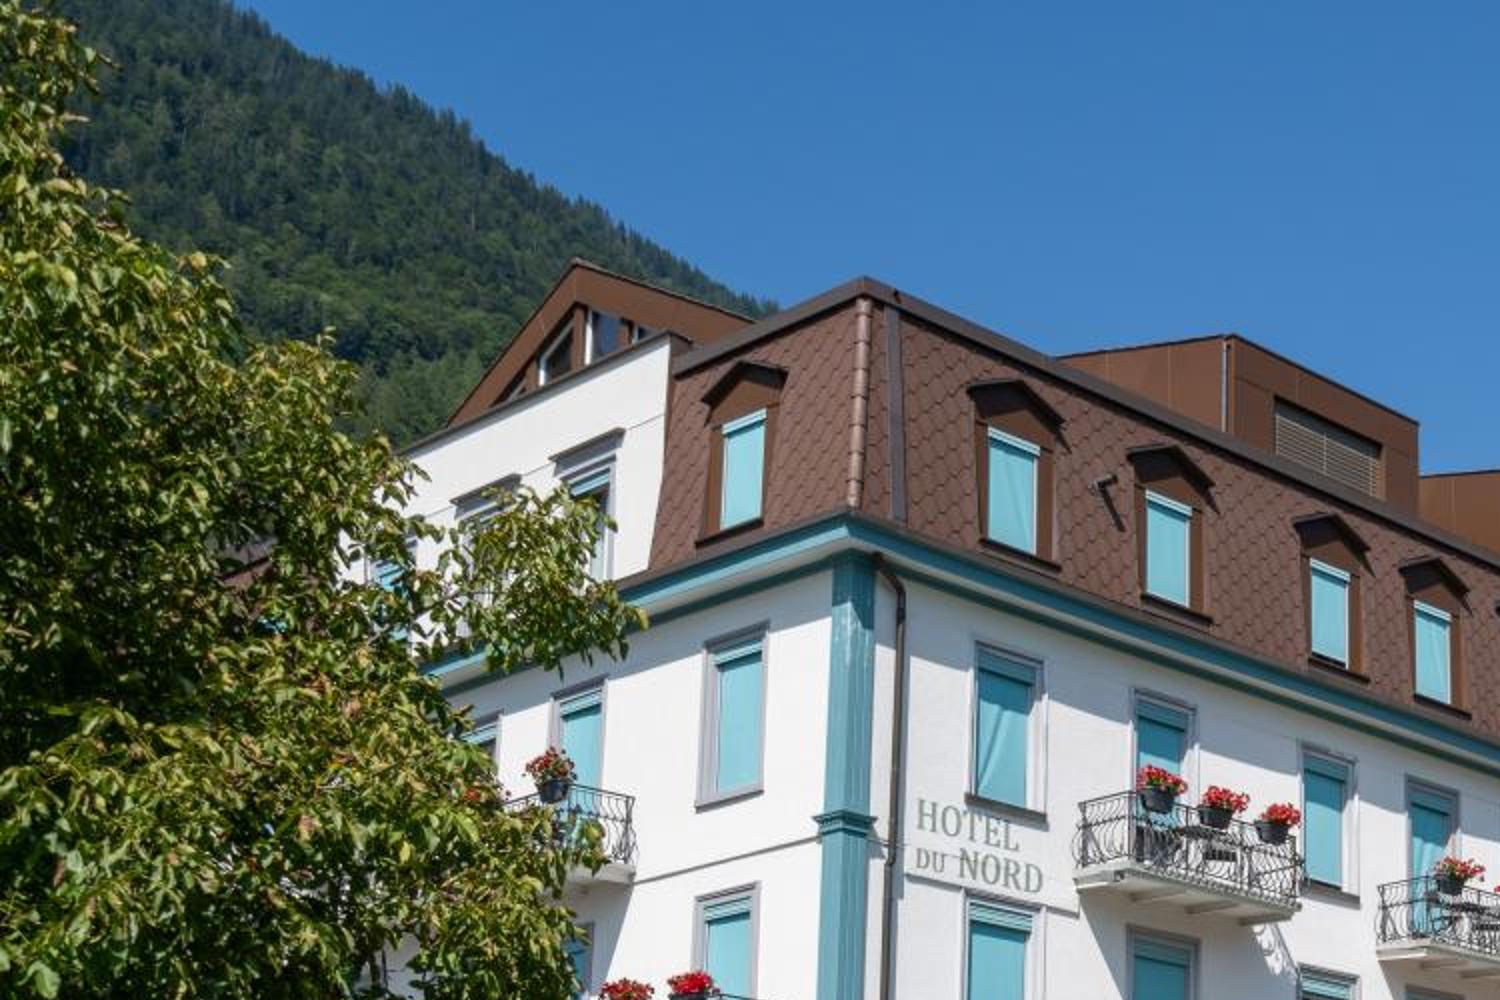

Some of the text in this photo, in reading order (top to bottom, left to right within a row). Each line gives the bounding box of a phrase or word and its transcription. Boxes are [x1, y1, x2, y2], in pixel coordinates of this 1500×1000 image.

[917, 798, 1019, 851] HOTEL
[916, 847, 1043, 893] DU NORD
